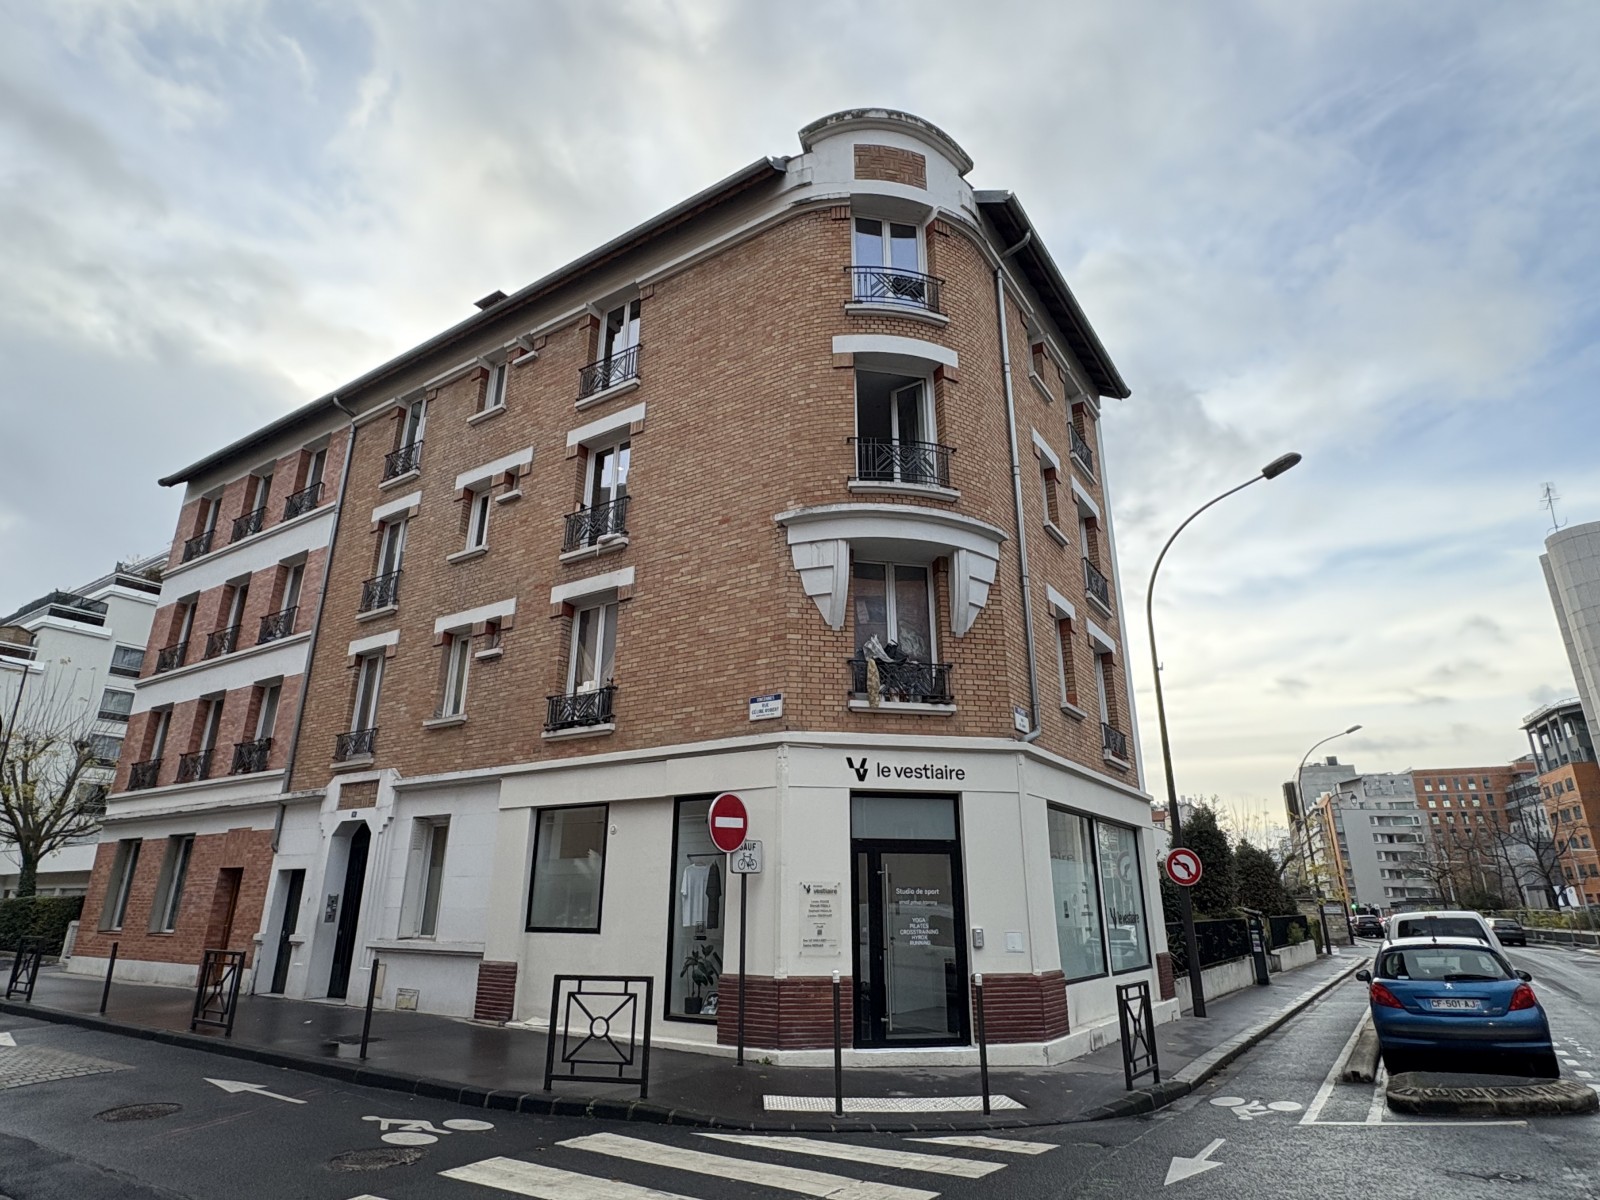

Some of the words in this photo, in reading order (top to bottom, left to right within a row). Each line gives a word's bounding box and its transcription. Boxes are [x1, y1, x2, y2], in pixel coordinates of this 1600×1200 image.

[877, 762, 891, 778] le
[894, 764, 965, 780] vestiaire
[739, 842, 757, 851] SAUF
[895, 887, 914, 895] Studio
[916, 887, 923, 895] de
[924, 888, 940, 896] sport
